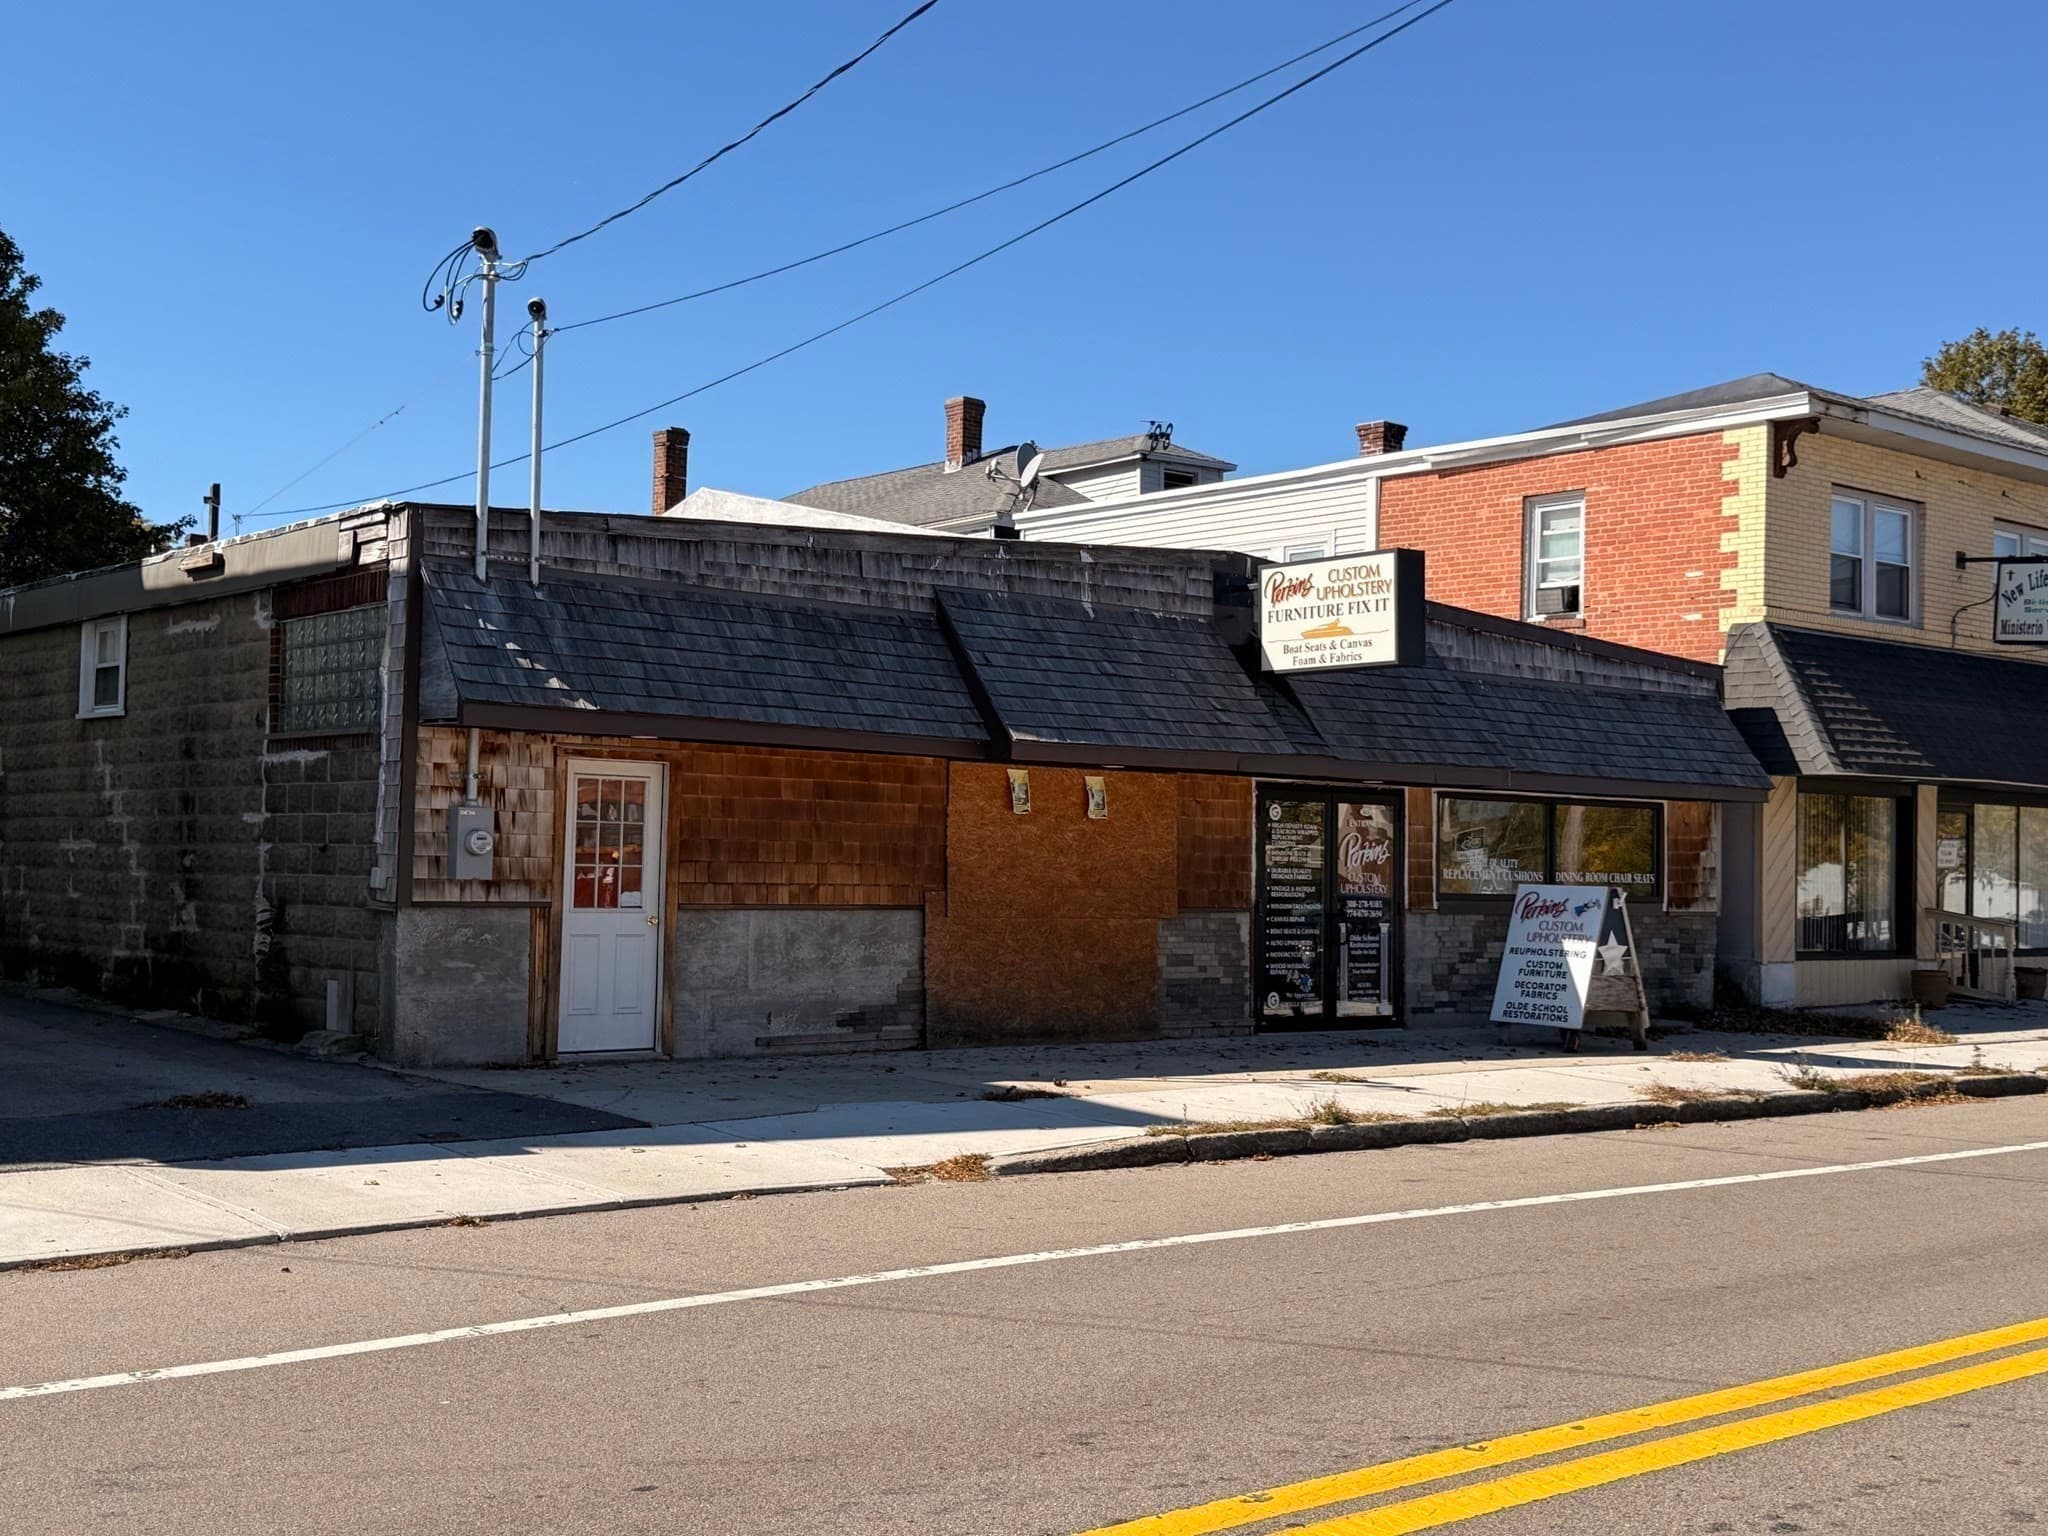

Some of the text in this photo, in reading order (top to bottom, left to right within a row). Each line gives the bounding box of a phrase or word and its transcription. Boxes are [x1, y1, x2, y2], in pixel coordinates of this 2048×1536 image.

[1328, 564, 1381, 583] CUSTOM
[1264, 571, 1315, 607] Perkins
[1316, 579, 1392, 601] UPHOLSTERY
[2001, 569, 2048, 608] New Life
[1268, 598, 1390, 623] FURNITURE FIX IT
[2000, 619, 2043, 635] Ministerio
[1283, 638, 1373, 655] Boat Seats & Canvas
[1292, 651, 1363, 666] Foam & Fabrics
[1340, 832, 1391, 868] Perkins
[1489, 858, 1519, 869] QUALITY
[1349, 872, 1381, 883] CUSTOM
[1443, 869, 1544, 882] REPLACEMENT CUSHIONS
[1555, 872, 1655, 884] DINING ROOM CHAIR SEATS
[1341, 883, 1387, 894] UPHOLSTERY
[1515, 891, 1569, 923] Perkins
[1538, 920, 1584, 932] CUSTOM
[1526, 932, 1592, 944] UPHOLSTERY
[1509, 947, 1588, 959] REUPHOLSTERING
[1526, 960, 1563, 969] CUSTOM
[1518, 968, 1567, 979] FURNITURE
[1514, 981, 1567, 992] DECORATOR
[1520, 989, 1558, 1001] FABRICS
[1505, 1001, 1568, 1014] OLDE SCHOOL
[1502, 1010, 1569, 1023] RESTORATIONS
